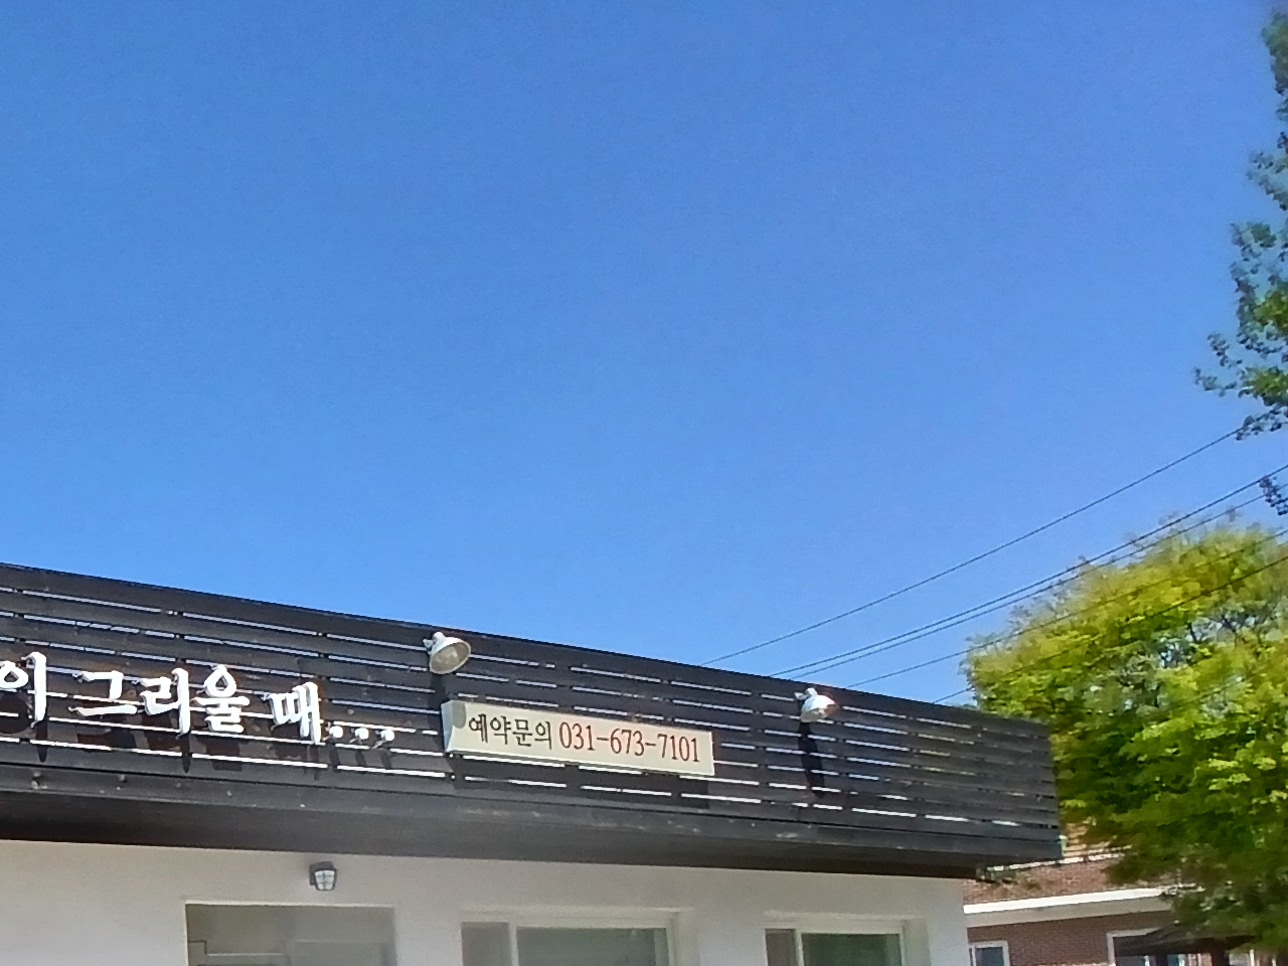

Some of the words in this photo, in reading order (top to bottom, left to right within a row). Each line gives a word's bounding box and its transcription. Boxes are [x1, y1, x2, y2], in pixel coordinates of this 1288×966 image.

[69, 665, 250, 737] 그리울
[468, 713, 552, 750] 예약문의
[559, 721, 700, 763] 031-673-7101
